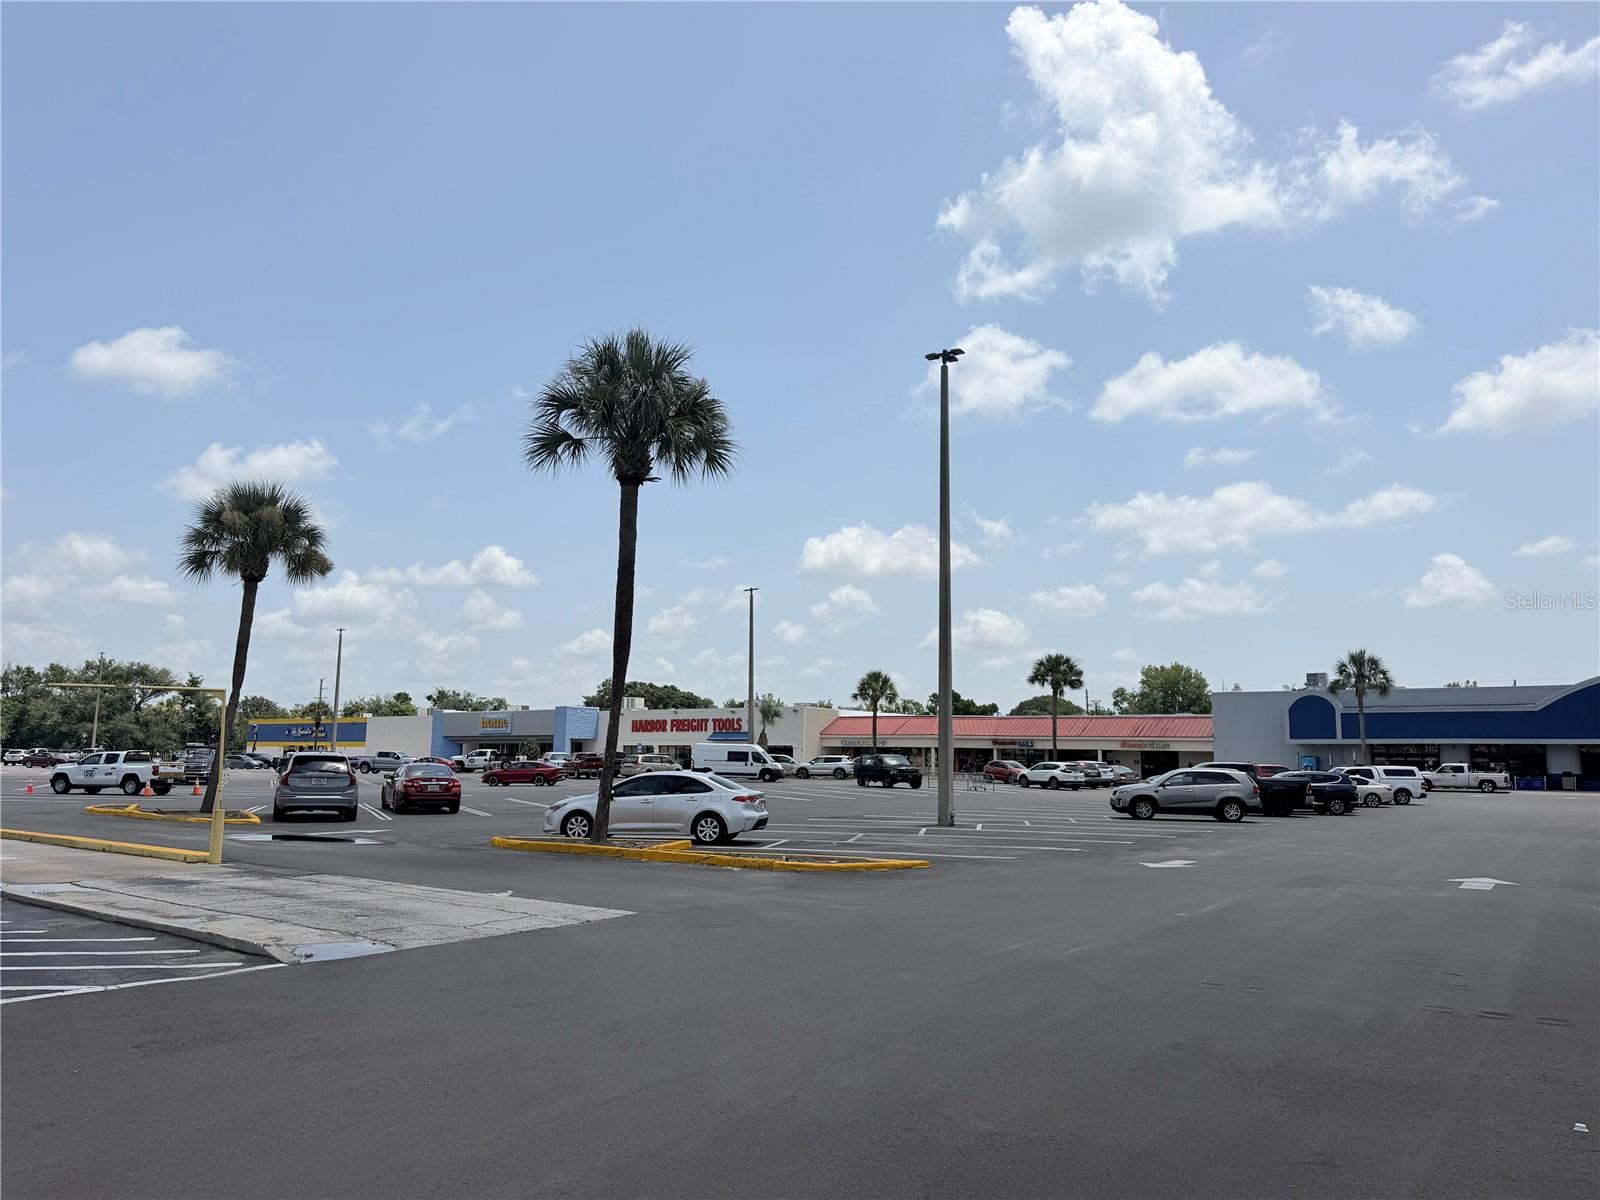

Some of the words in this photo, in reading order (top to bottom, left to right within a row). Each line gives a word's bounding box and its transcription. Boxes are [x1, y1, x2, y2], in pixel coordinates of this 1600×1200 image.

[631, 719, 668, 732] HARBOR
[669, 718, 710, 732] FREIGHT
[711, 717, 743, 732] TOOLS
